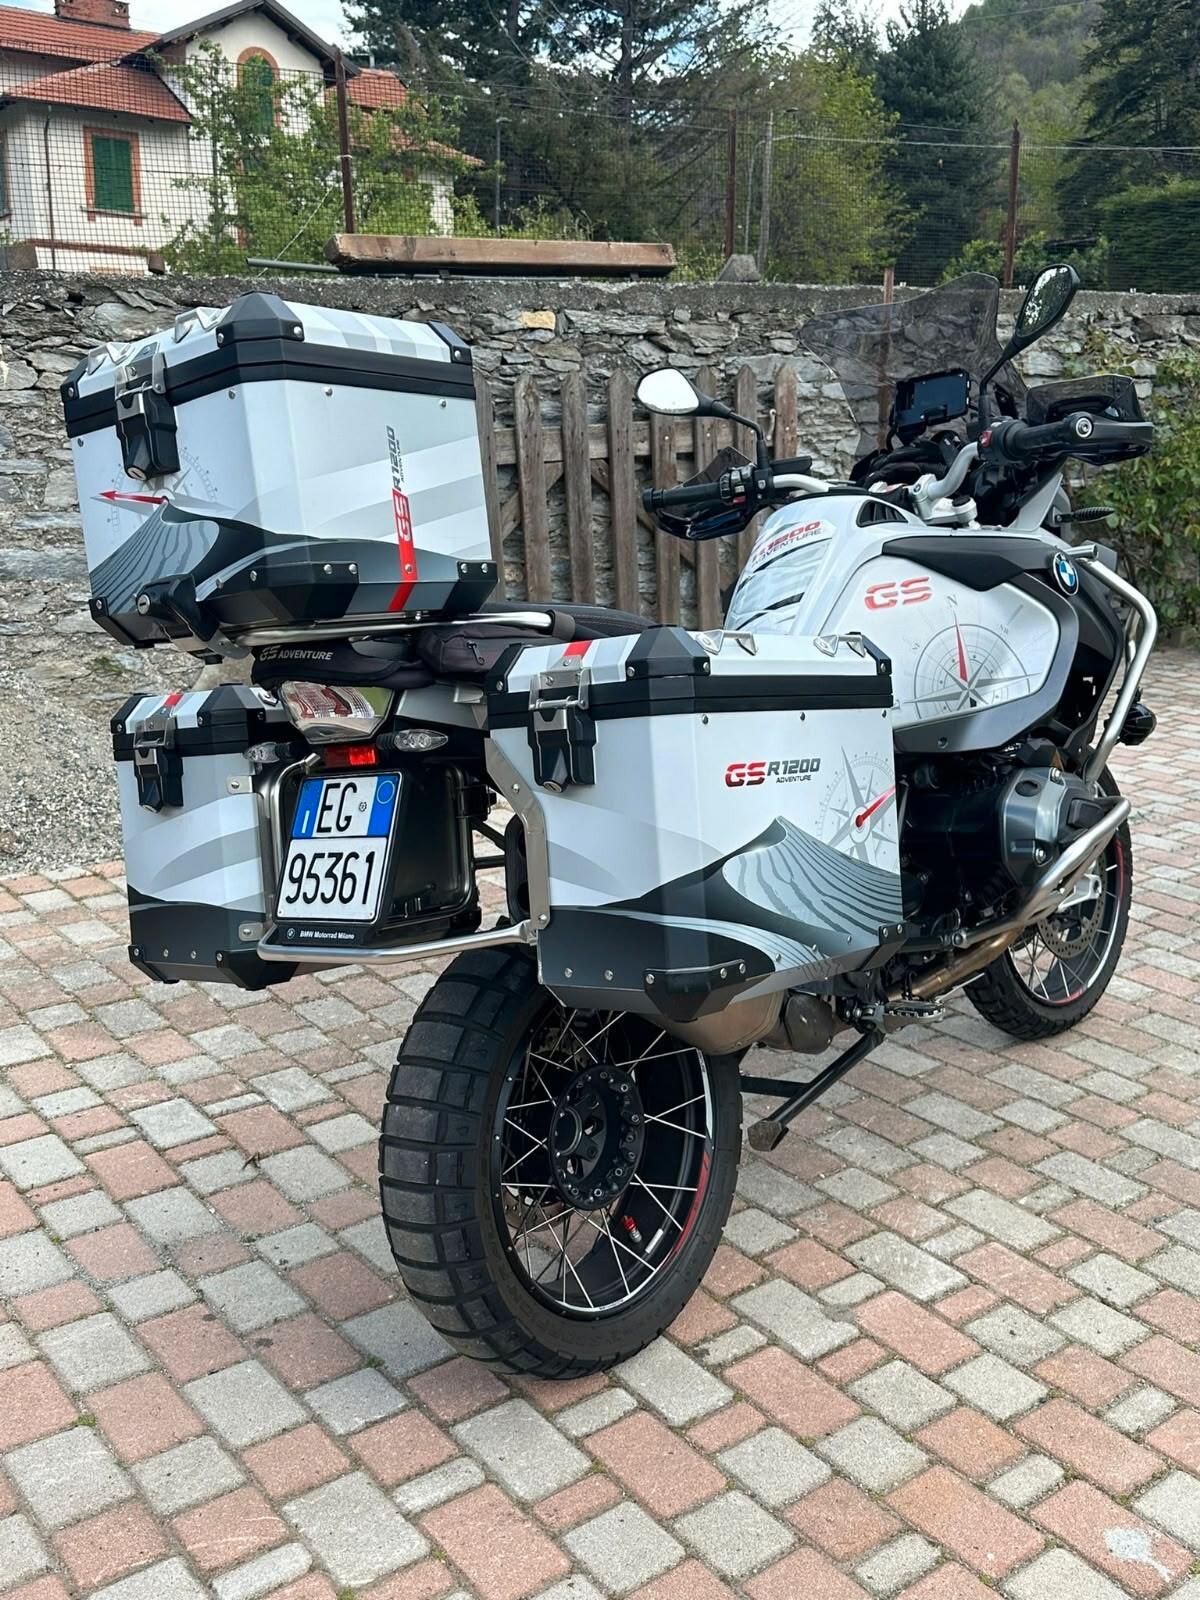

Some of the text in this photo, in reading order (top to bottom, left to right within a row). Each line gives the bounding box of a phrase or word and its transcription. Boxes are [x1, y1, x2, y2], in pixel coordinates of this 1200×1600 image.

[395, 494, 412, 542] GS
[864, 576, 932, 611] GS
[260, 645, 333, 661] GS ADVENTURE
[725, 762, 766, 787] GS
[776, 774, 812, 784] ADVENTURE
[316, 782, 358, 833] EG
[285, 851, 376, 904] 95361
[314, 931, 337, 939] Motorrad
